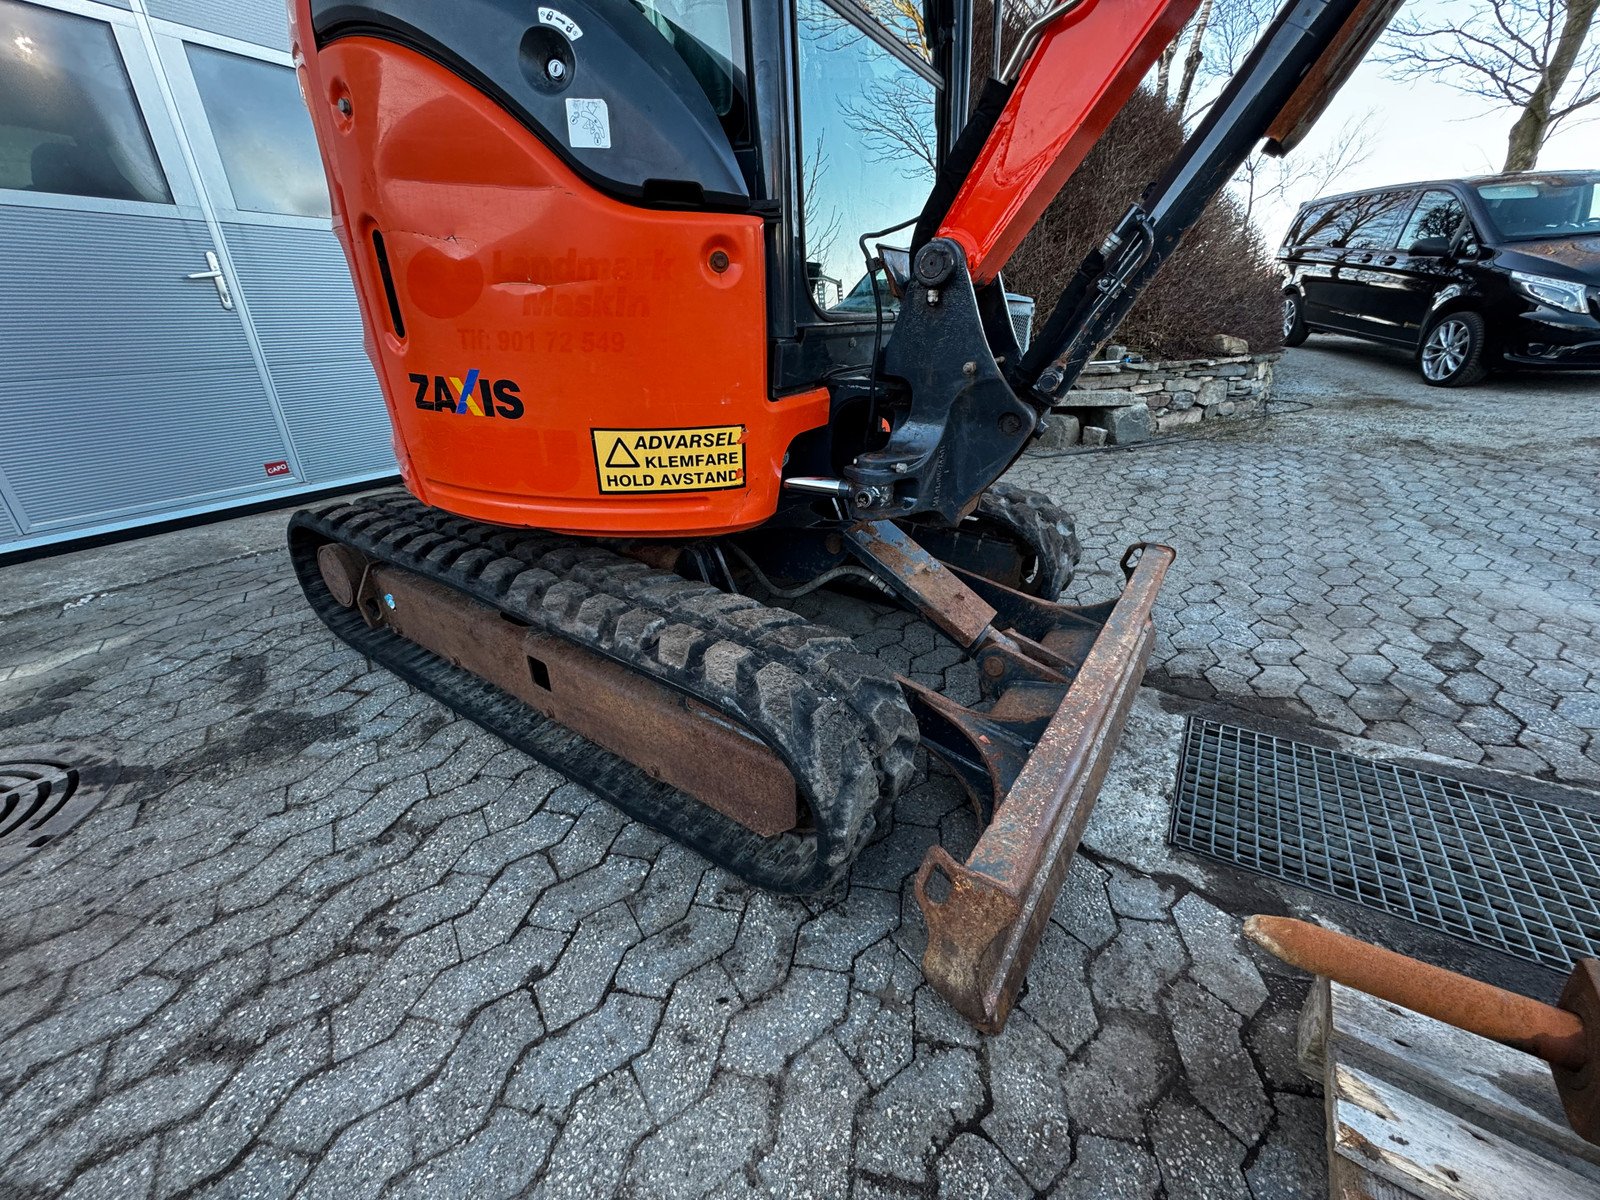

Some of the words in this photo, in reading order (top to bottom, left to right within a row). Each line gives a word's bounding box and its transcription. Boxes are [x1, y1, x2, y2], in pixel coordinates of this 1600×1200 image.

[497, 330, 535, 352] 901
[546, 331, 573, 353] 72
[580, 331, 625, 354] 549
[408, 369, 525, 419] ZAXIS
[634, 432, 738, 450] ADVARSEL
[645, 452, 738, 469] KLEMFARE
[606, 474, 655, 487] HOLD
[660, 470, 741, 486] AVSTAND
